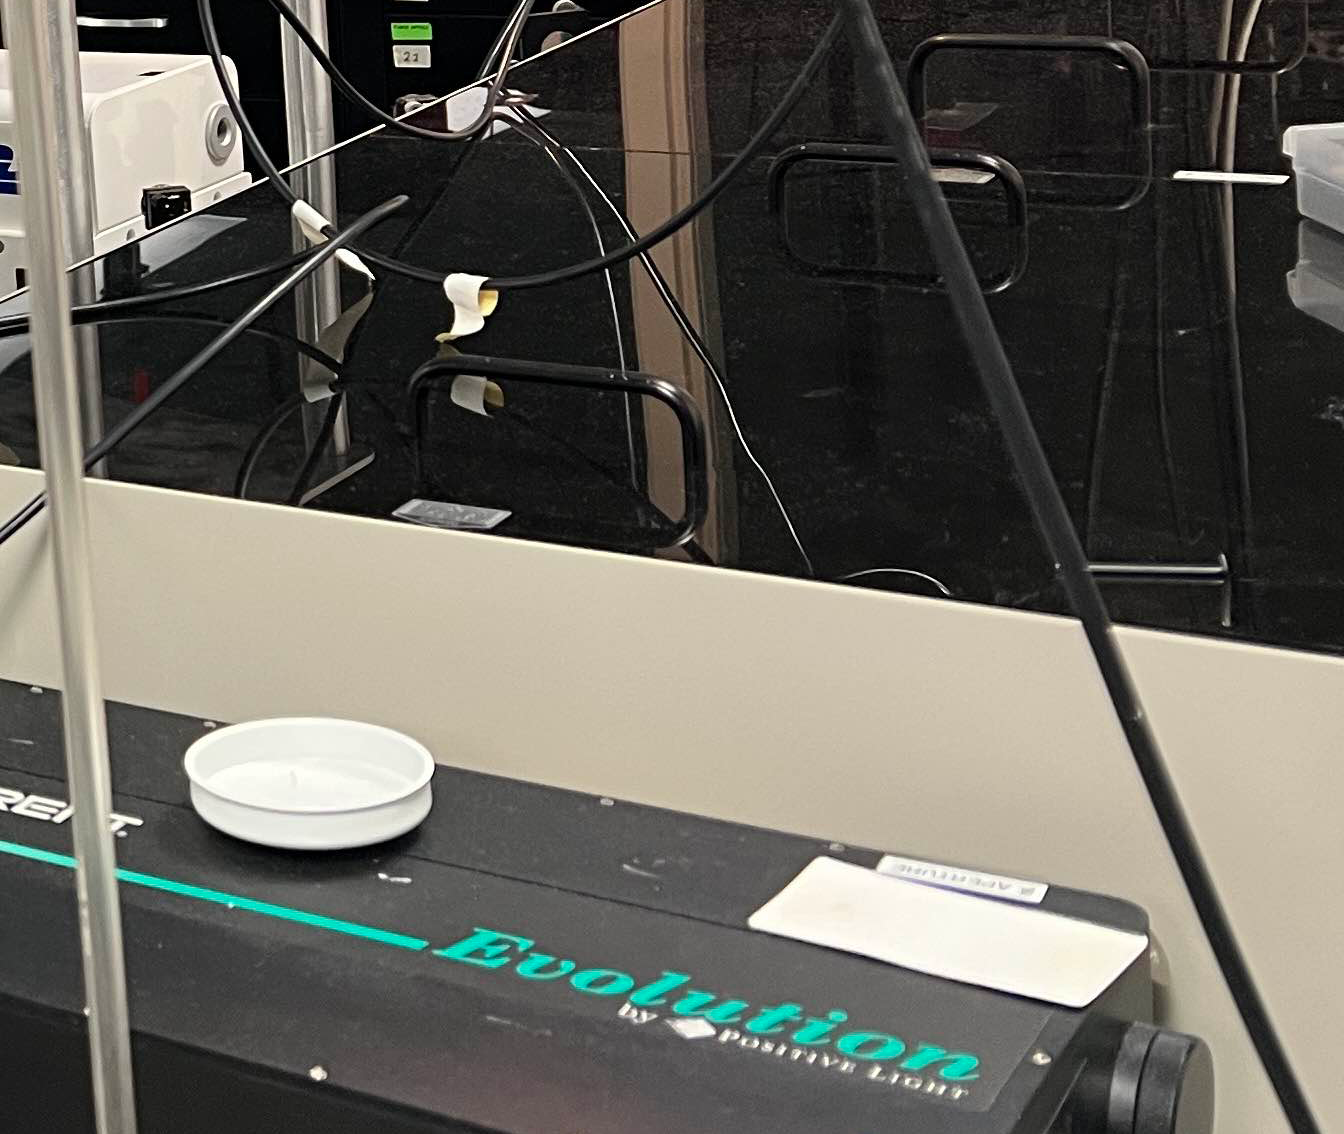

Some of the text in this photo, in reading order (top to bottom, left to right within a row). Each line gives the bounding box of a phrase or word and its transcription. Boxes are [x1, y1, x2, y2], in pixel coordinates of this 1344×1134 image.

[431, 926, 982, 1082] Evolution
[617, 1001, 970, 1101] by POSITIVE LIGHT
